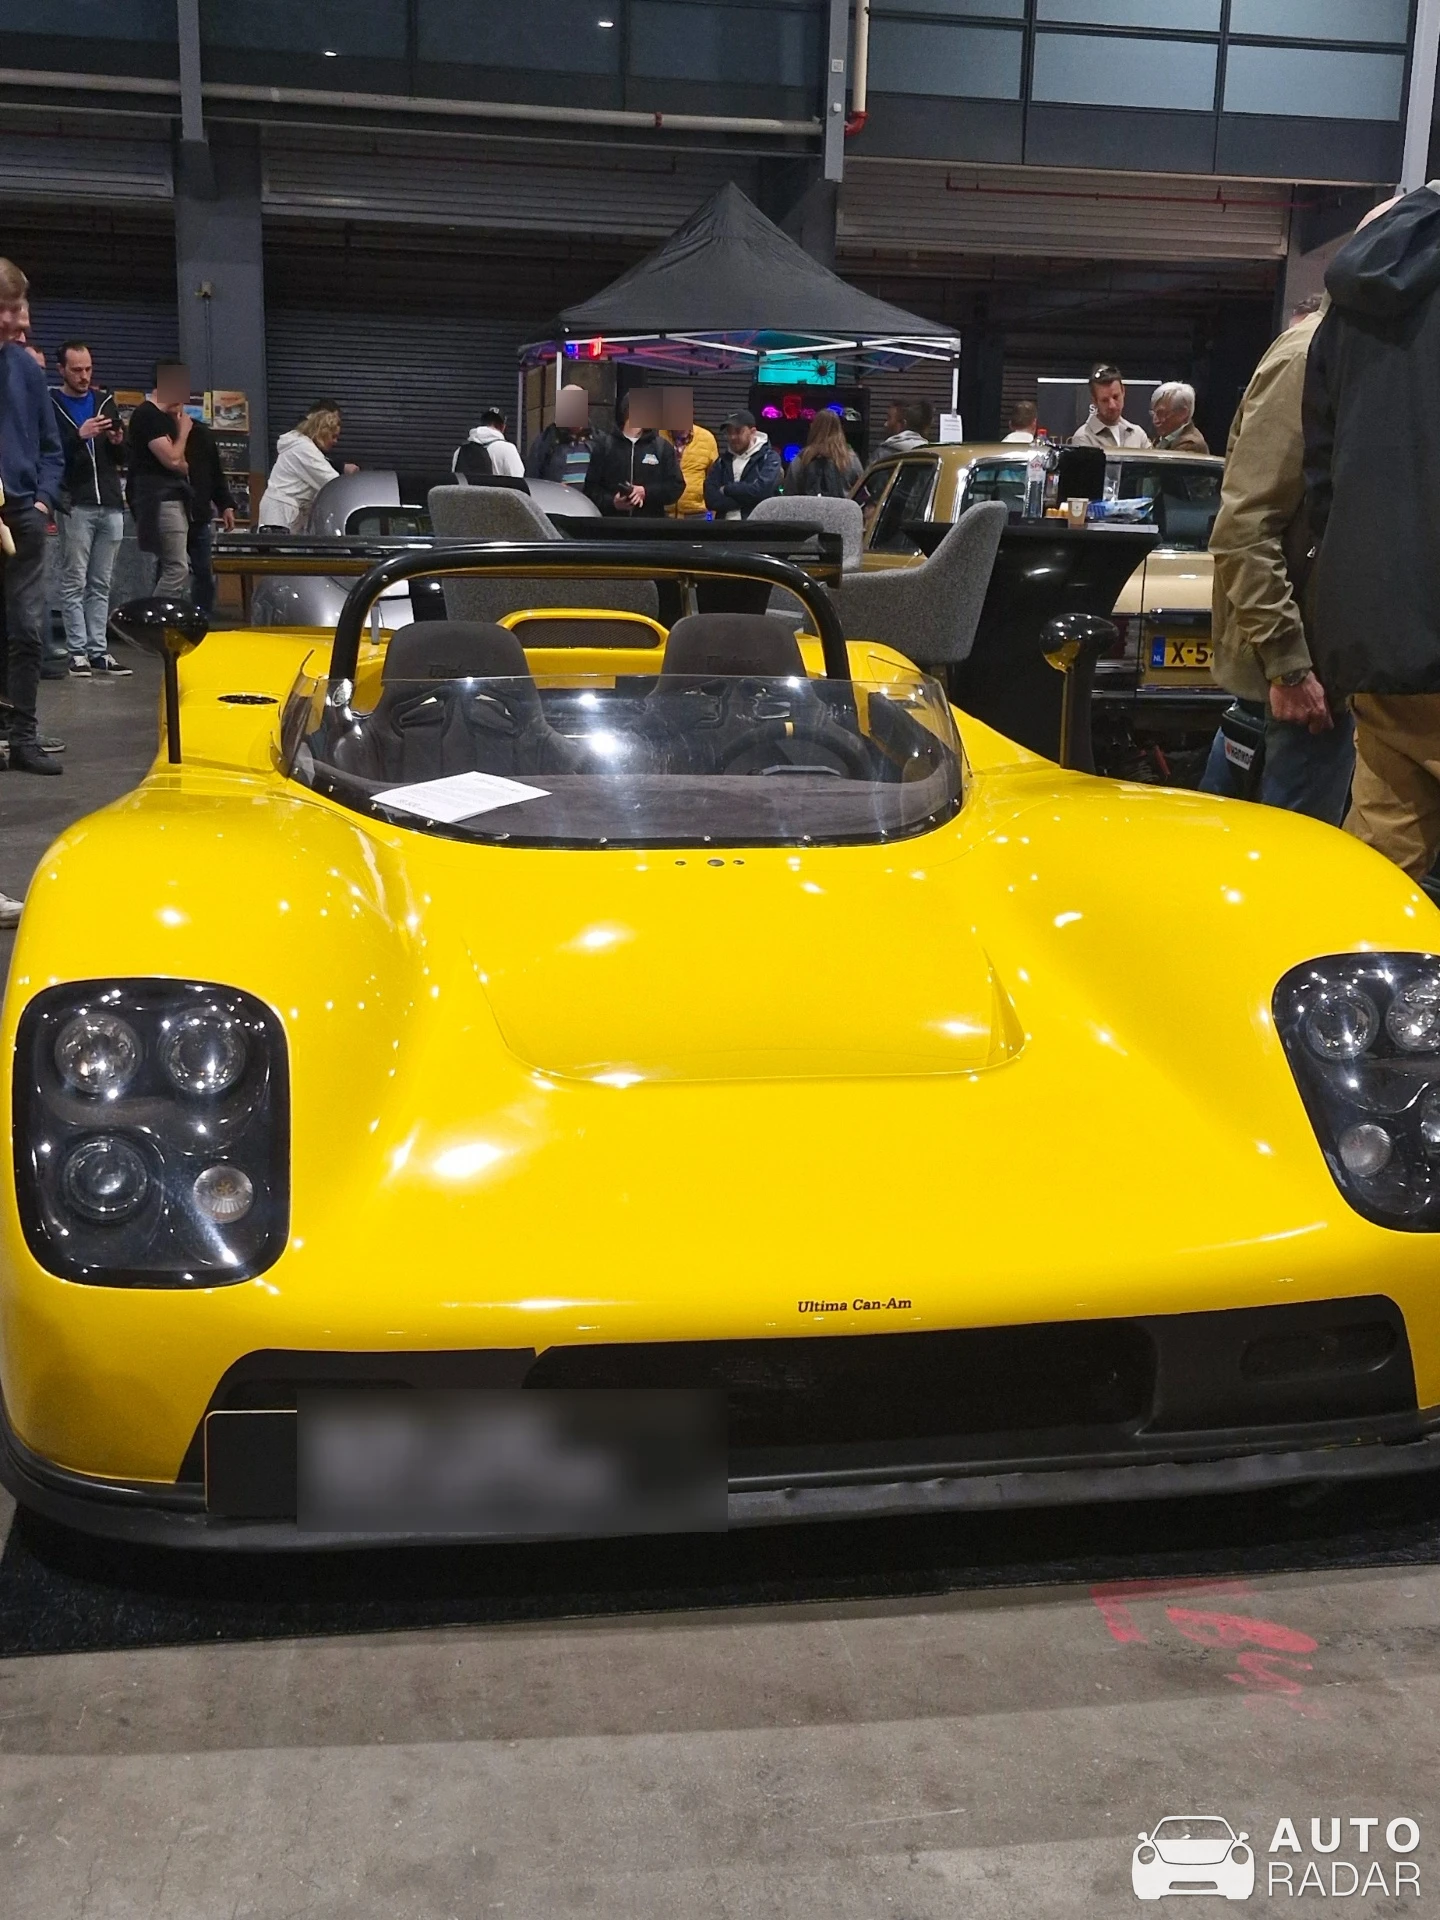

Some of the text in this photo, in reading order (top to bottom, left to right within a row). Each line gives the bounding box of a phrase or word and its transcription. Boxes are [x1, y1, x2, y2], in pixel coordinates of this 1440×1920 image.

[1153, 654, 1163, 662] NL
[1171, 642, 1214, 664] X-5
[798, 1297, 912, 1313] Ultima Can-Am
